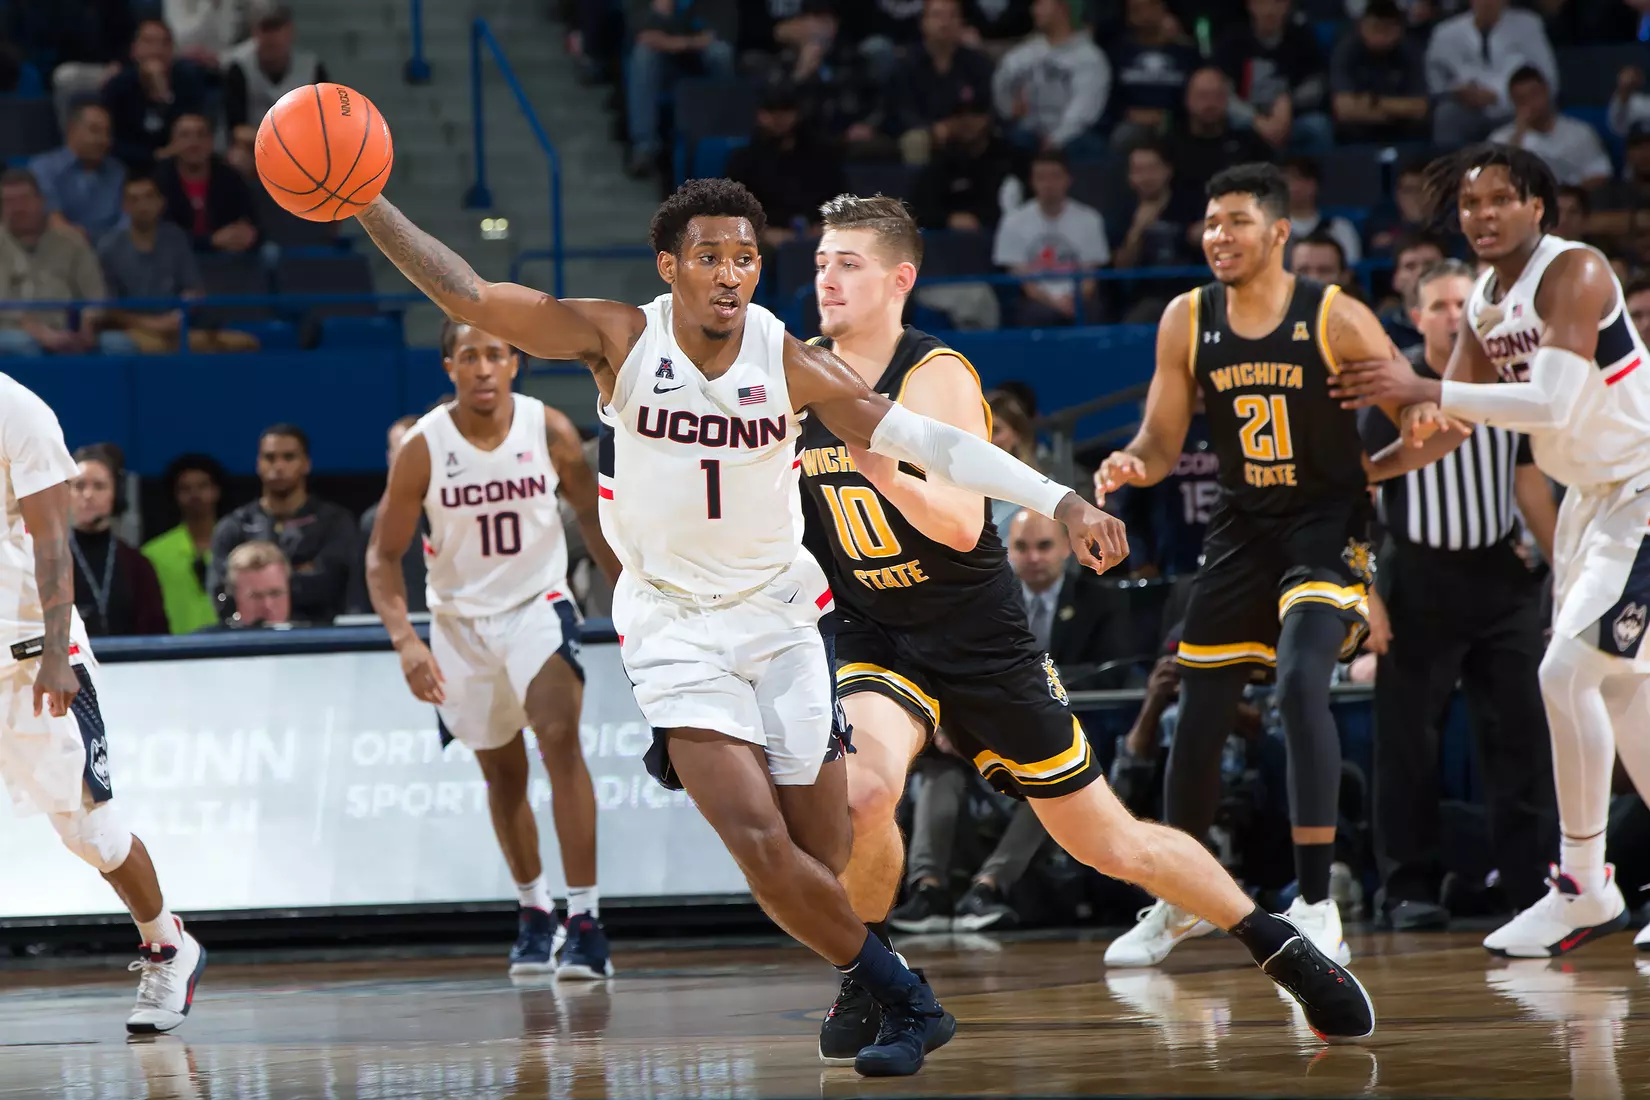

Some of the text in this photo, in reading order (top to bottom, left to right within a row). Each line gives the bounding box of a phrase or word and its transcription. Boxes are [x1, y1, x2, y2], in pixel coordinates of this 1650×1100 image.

[1210, 362, 1304, 393] WICHITA
[636, 405, 788, 449] UCONN
[1233, 393, 1294, 462] 21
[801, 445, 858, 477] WICH
[1244, 462, 1298, 488] STATE
[440, 474, 546, 508] UCONN
[700, 458, 722, 520] 1
[476, 511, 522, 557] 10
[819, 484, 903, 561] 10
[853, 559, 930, 592] STATE
[345, 779, 488, 819] SPORT
